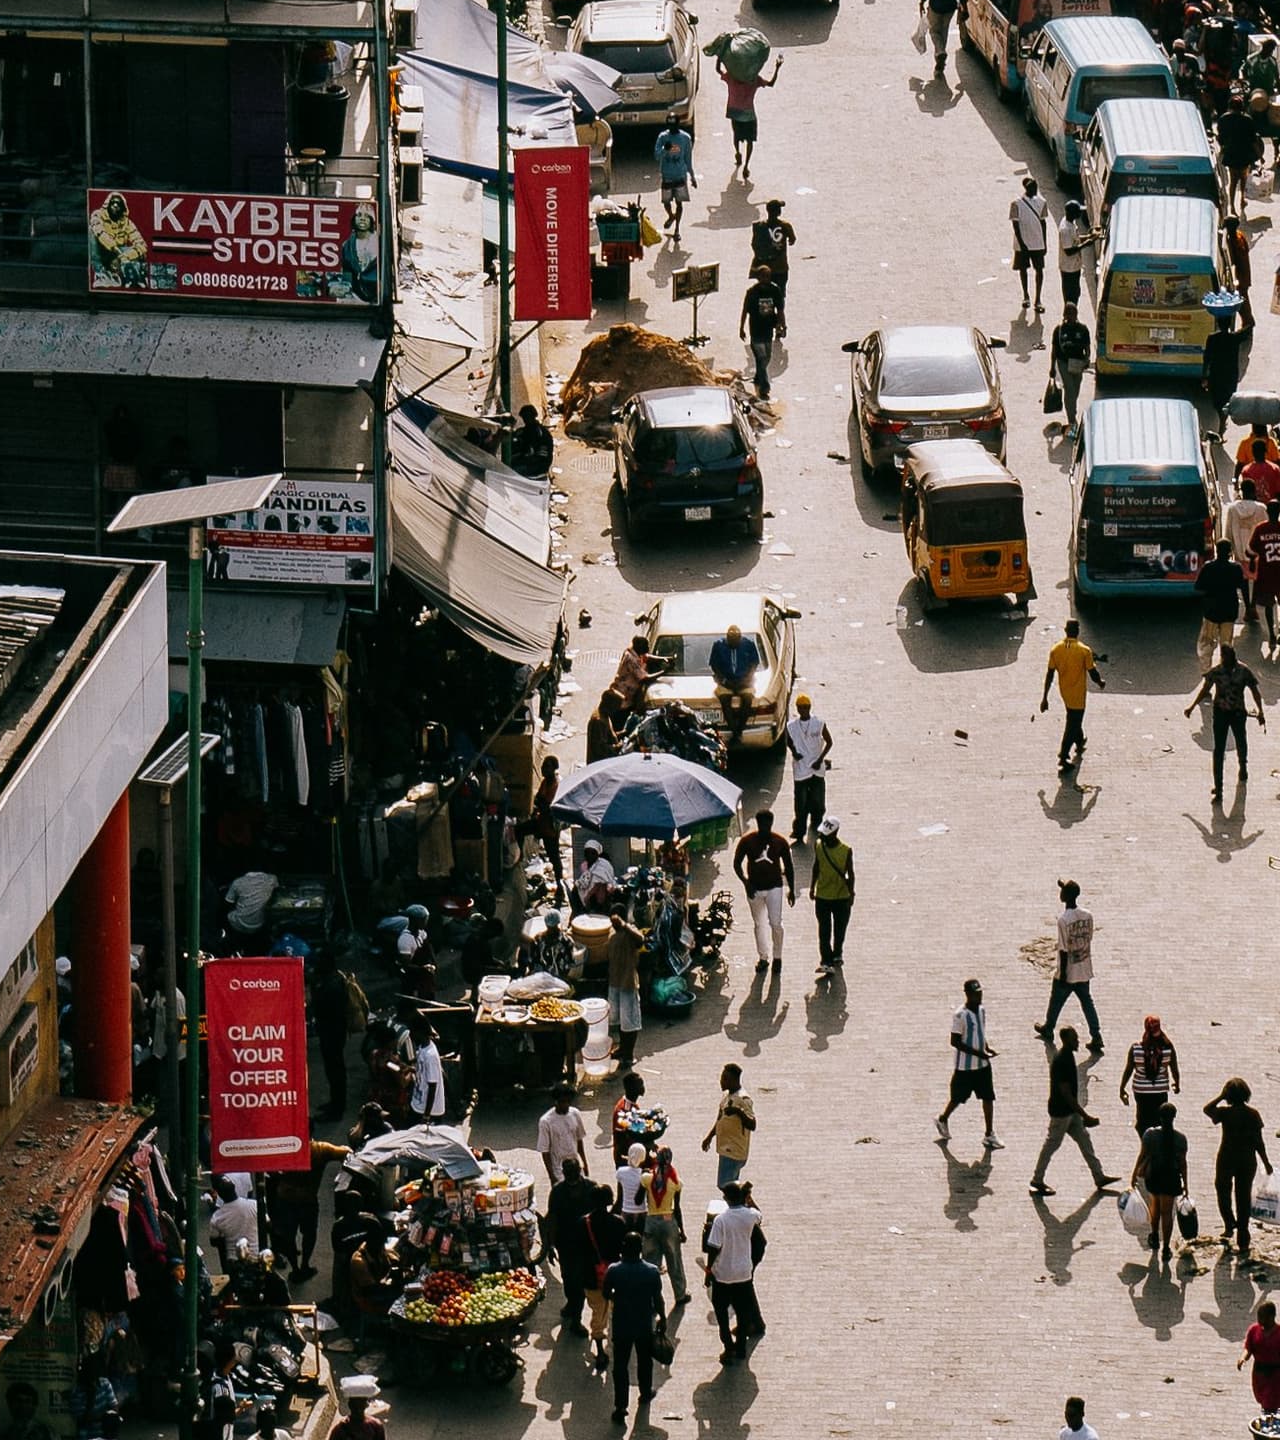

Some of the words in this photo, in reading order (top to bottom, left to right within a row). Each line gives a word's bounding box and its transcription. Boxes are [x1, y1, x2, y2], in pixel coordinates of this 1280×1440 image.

[545, 187, 558, 230] MOVE
[153, 197, 340, 240] KAYBEE
[213, 236, 339, 267] STORES
[546, 234, 559, 311] DIFFERENT
[194, 271, 288, 292] 08086021728
[271, 490, 305, 498] MAGIC
[309, 491, 351, 500] GLOBAL
[1104, 496, 1126, 506] Find
[1128, 496, 1150, 506] Your
[1152, 496, 1177, 508] Edge
[1104, 507, 1114, 515] in
[243, 978, 281, 989] carbon
[228, 1024, 286, 1041] CLAIM
[231, 1047, 284, 1064] YOUR
[229, 1070, 288, 1086] OFFER
[221, 1090, 298, 1109] TODAY!!!
